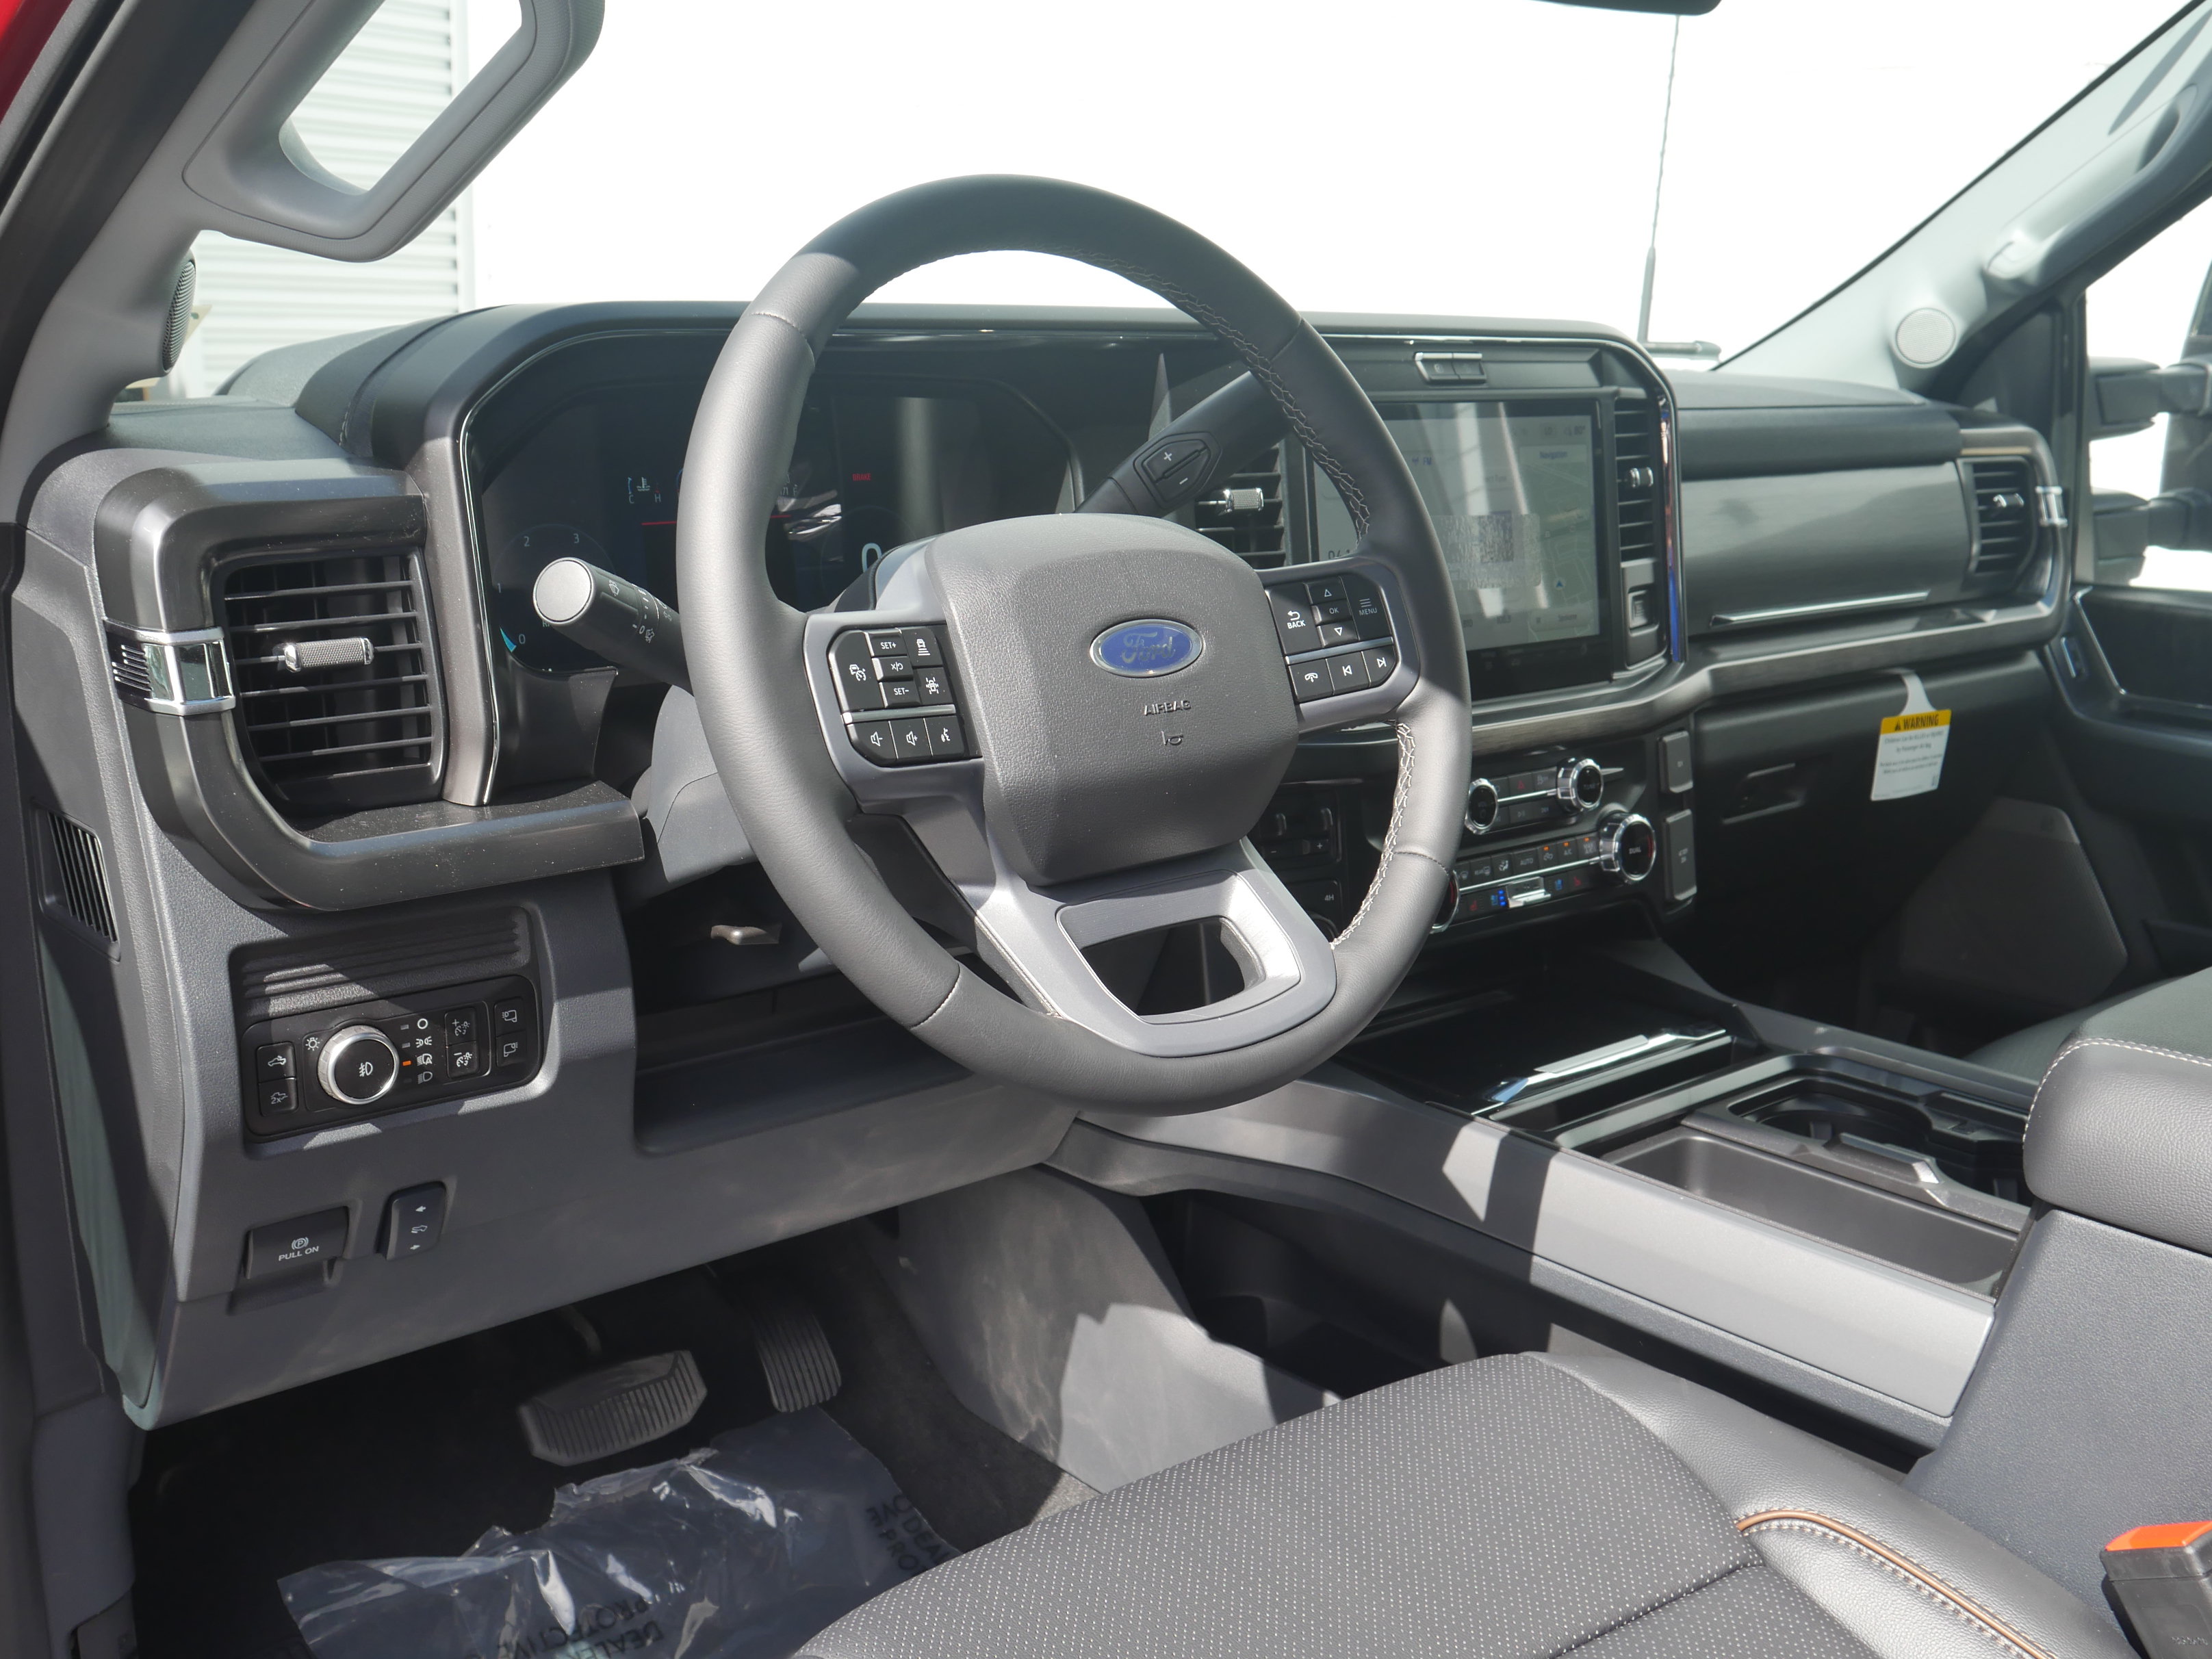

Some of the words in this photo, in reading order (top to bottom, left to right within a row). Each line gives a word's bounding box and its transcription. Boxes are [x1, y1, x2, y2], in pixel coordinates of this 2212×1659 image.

[852, 473, 871, 481] BRAKE
[629, 494, 634, 504] C
[654, 493, 661, 502] H
[524, 536, 530, 547] 2
[573, 532, 580, 544] 3
[497, 582, 502, 593] 1
[1359, 607, 1378, 616] MENU
[1287, 620, 1306, 629] BACK
[518, 633, 526, 645] 0
[880, 641, 897, 650] SET+
[1122, 631, 1176, 664] Ford
[1144, 699, 1192, 716] AIRBAG
[1903, 714, 1939, 730] WARNING
[1520, 858, 1534, 866] AUTO
[278, 1250, 303, 1261] PULL
[304, 1246, 319, 1255] ON
